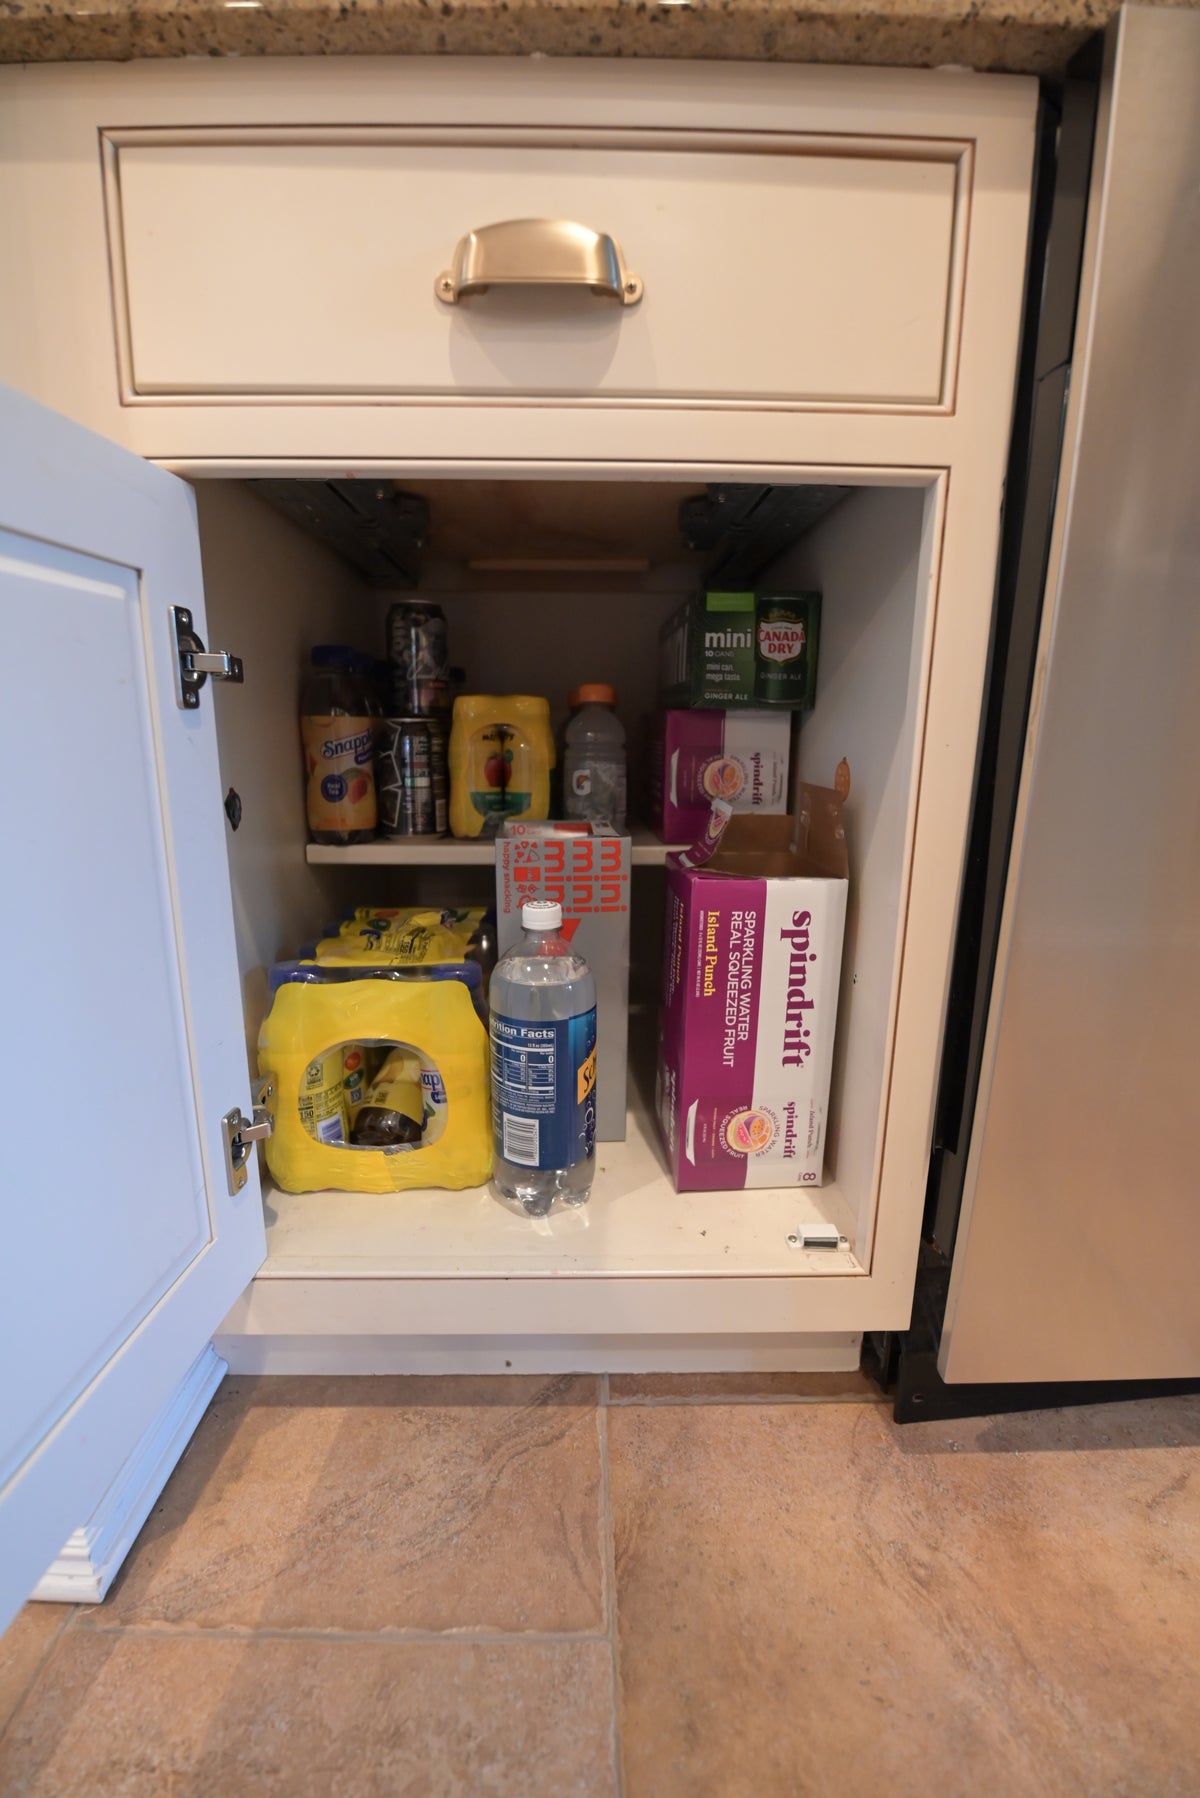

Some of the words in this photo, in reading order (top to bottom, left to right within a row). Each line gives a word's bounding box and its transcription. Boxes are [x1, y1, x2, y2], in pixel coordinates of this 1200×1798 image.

[704, 628, 752, 649] mini
[757, 628, 806, 643] CANADA
[767, 642, 794, 654] DRY
[705, 673, 723, 683] mega
[706, 662, 721, 671] mini
[760, 672, 788, 681] GINGER
[788, 672, 802, 681] ALE
[704, 692, 733, 700] GINGER
[734, 693, 748, 701] ALE
[322, 728, 374, 758] Snappl
[750, 752, 763, 806] spindrift
[510, 824, 526, 835] 10
[502, 841, 511, 871] happy
[544, 840, 572, 913] min
[572, 840, 600, 912] mini
[600, 840, 628, 912] mini
[502, 872, 511, 914] snacking
[706, 910, 720, 952] Island
[729, 911, 743, 949] REAL
[740, 911, 756, 989] SPARKLING
[703, 955, 717, 997] Punch
[725, 951, 740, 1026] SQUEEZED
[780, 910, 817, 1068] spindrift
[737, 993, 751, 1041] WATER
[520, 1028, 555, 1038] Facts
[520, 1054, 526, 1062] 0
[548, 1055, 554, 1063] 0
[722, 1029, 734, 1068] FRUIT
[729, 1104, 749, 1116] REAL
[758, 1105, 781, 1138] SPARKLING
[718, 1114, 732, 1151] SQUEEZED
[782, 1101, 798, 1159] spindrift
[724, 1148, 745, 1160] FRUIT
[755, 1139, 778, 1158] WATER
[802, 1172, 817, 1181] 8
